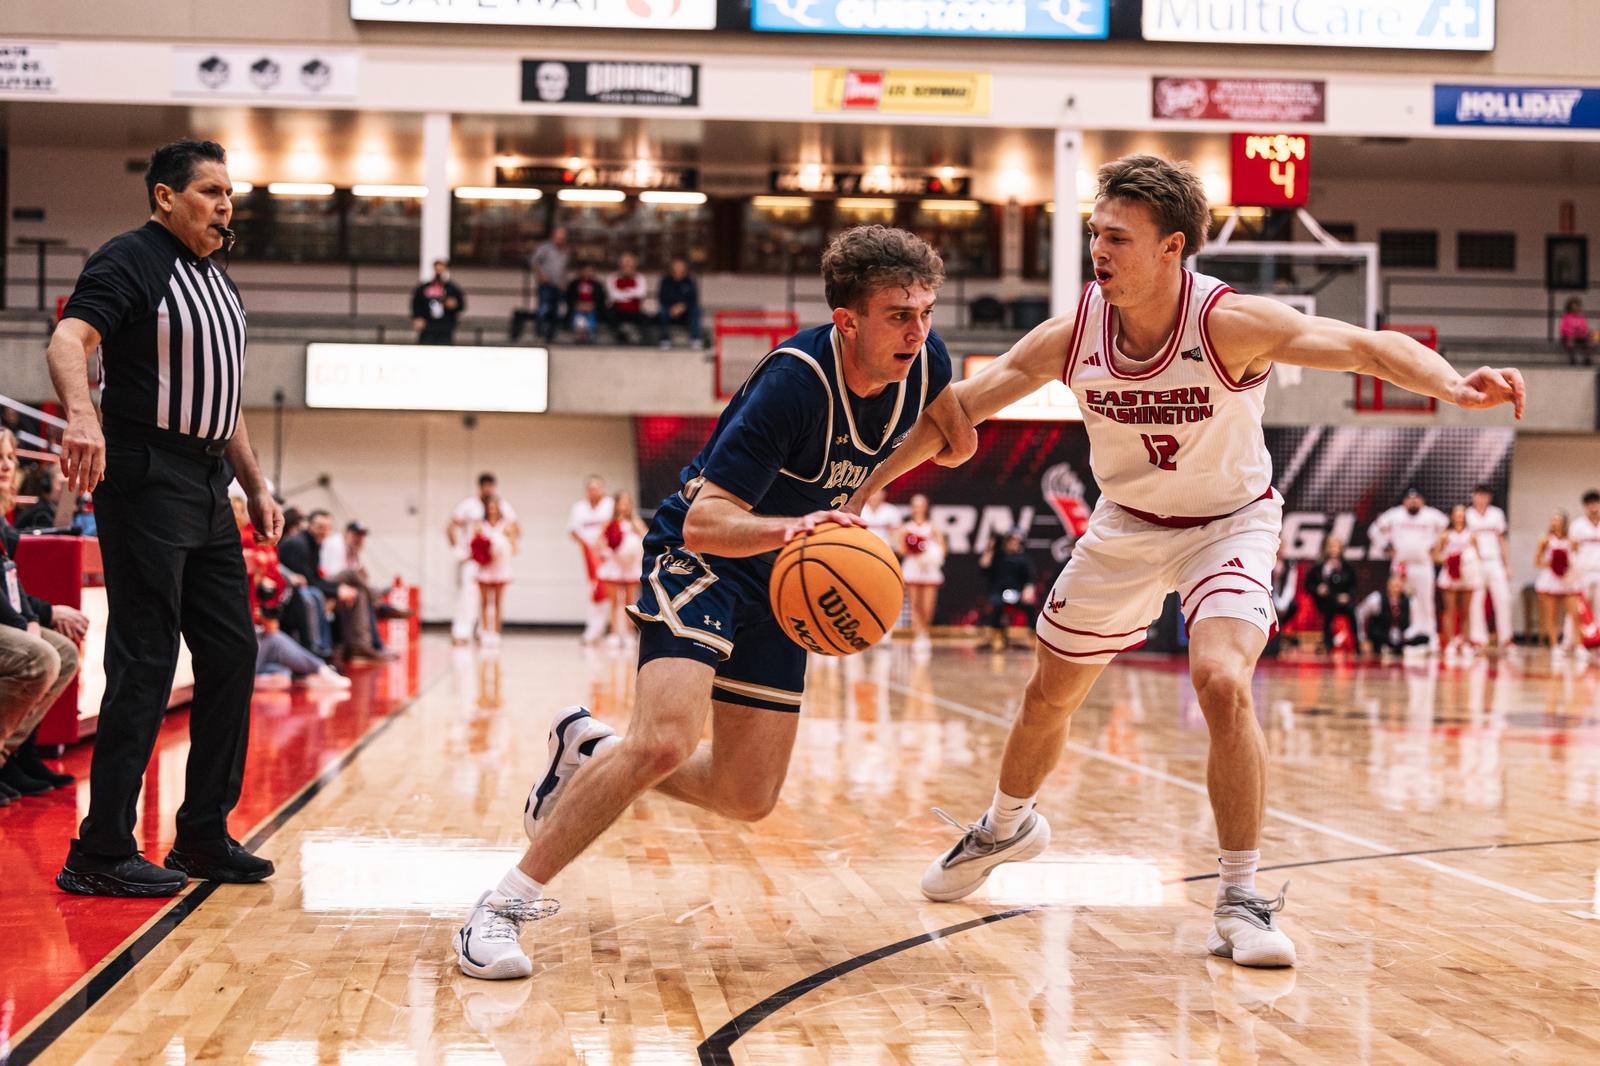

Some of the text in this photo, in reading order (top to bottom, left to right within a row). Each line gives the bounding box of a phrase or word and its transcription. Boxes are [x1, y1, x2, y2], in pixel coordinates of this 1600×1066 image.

[1157, 0, 1403, 36] MultiCare
[1460, 89, 1579, 119] HOLLIDAY
[1269, 160, 1295, 199] 4
[1085, 386, 1211, 406] EASTERN
[1087, 404, 1214, 425] WASHINGTON
[1140, 433, 1180, 471] 12
[818, 586, 871, 651] Wilson
